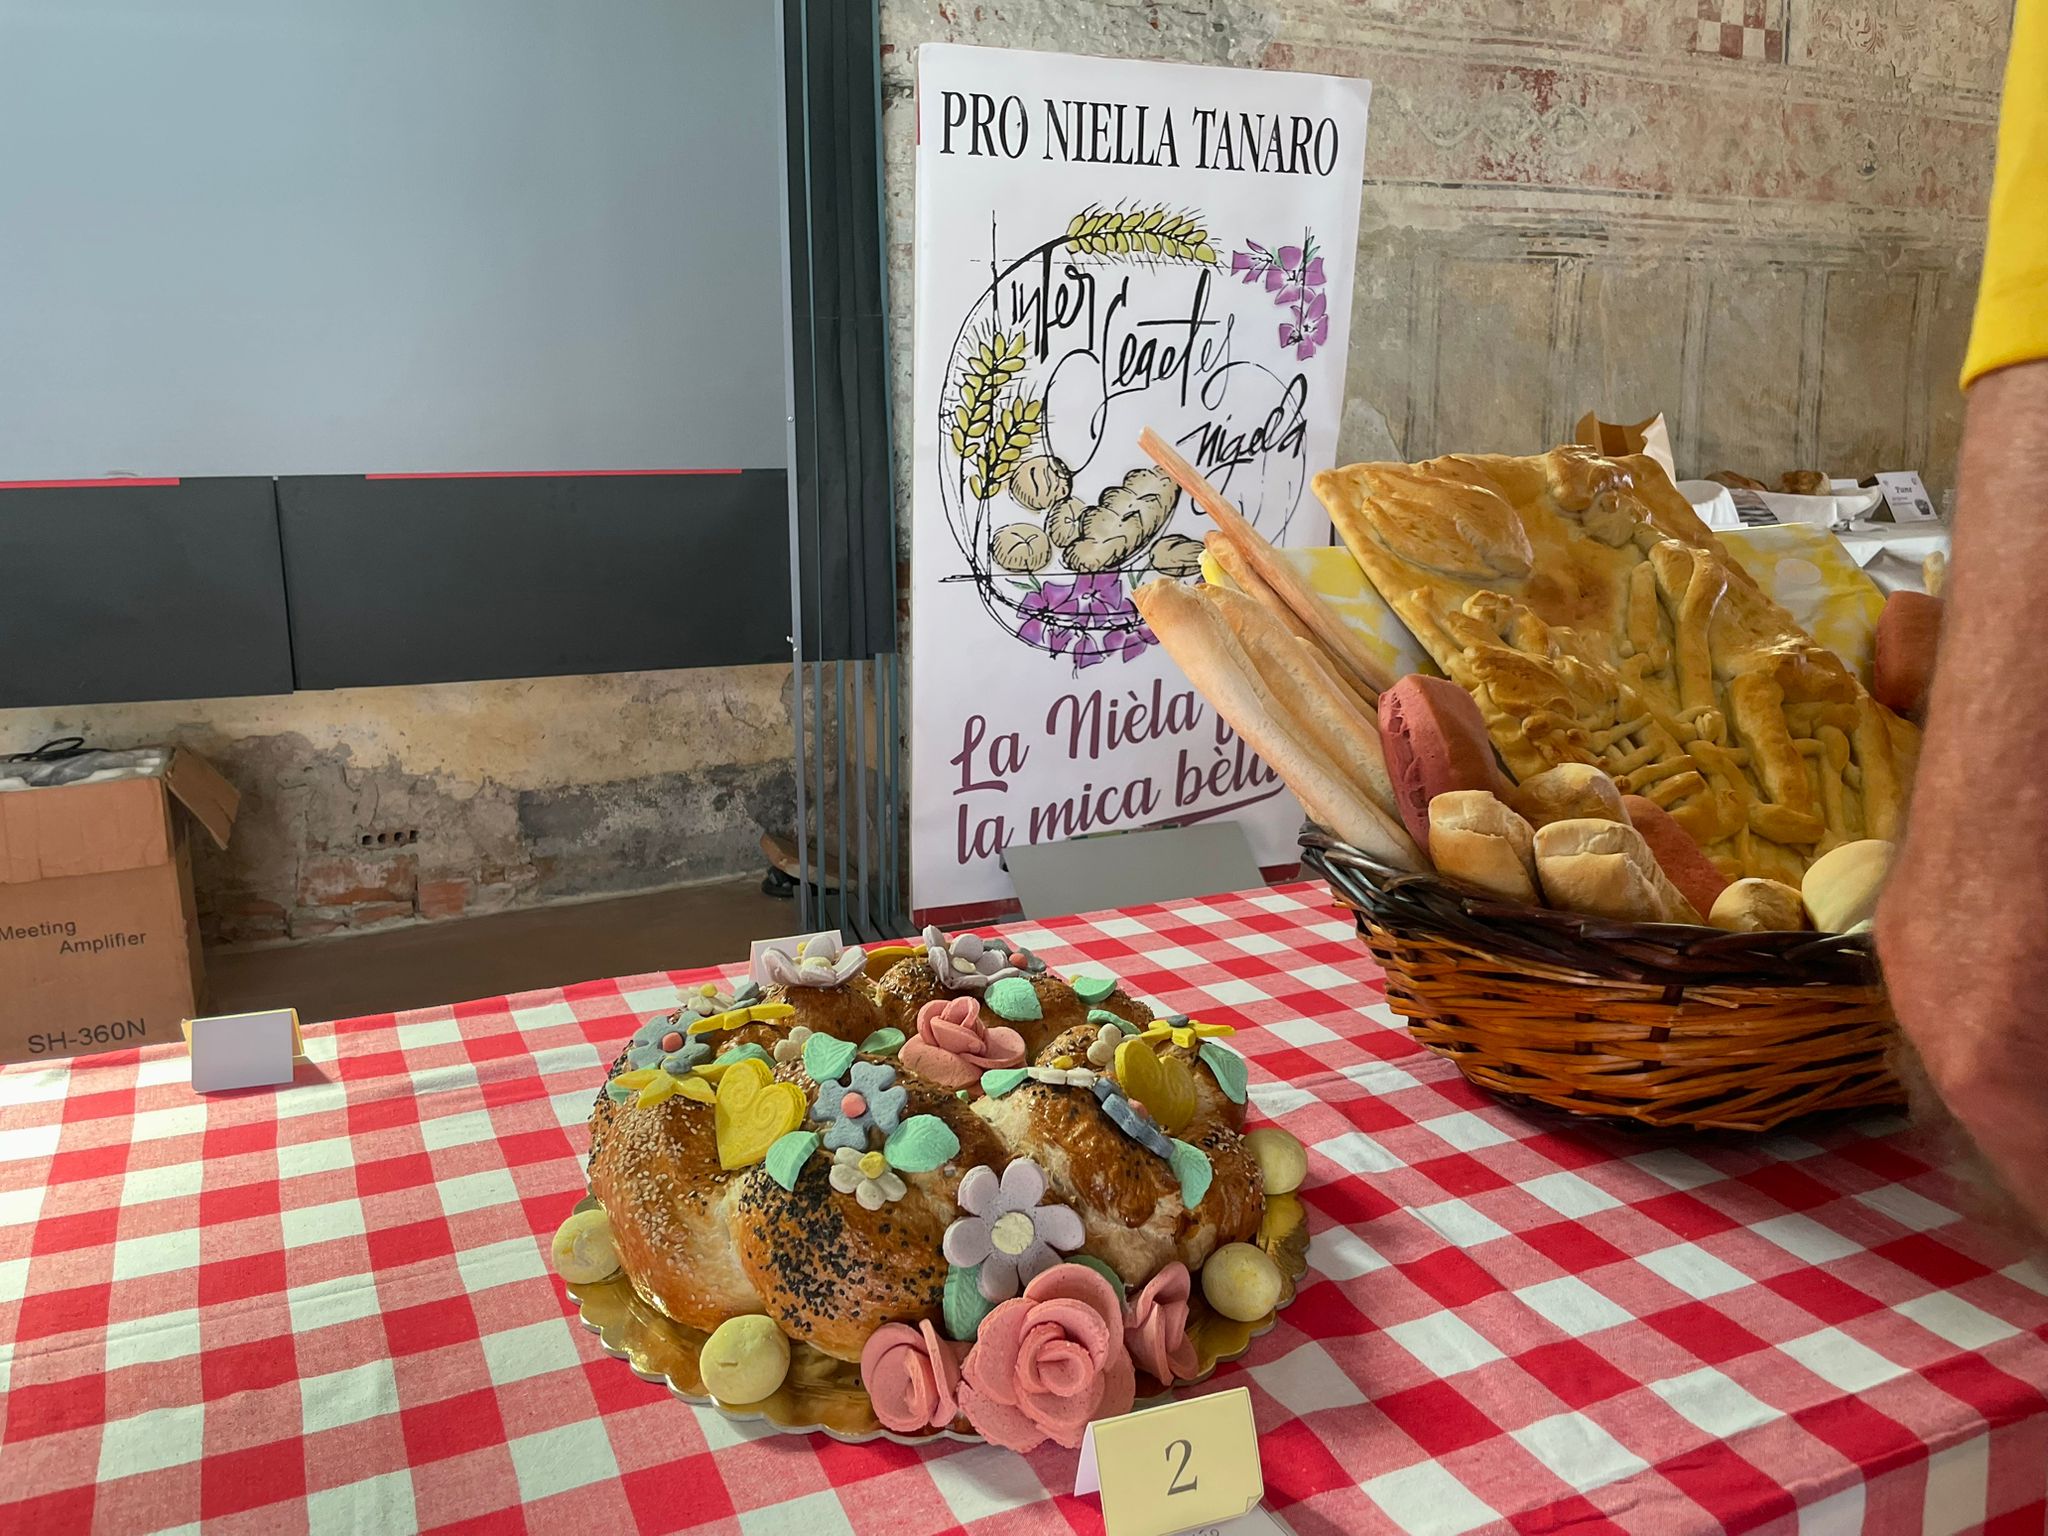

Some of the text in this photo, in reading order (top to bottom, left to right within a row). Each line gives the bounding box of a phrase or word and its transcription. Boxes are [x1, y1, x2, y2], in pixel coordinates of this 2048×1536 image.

[940, 91, 1340, 176] PRO NIELLA TANARO
[949, 714, 1030, 796] La
[1046, 678, 1204, 760] Nièla
[957, 803, 1015, 865] la
[1028, 777, 1160, 845] mica
[0, 920, 77, 941] Meeting
[59, 931, 147, 955] Amplifier
[27, 1017, 147, 1054] SH-360N
[1164, 1438, 1199, 1496] 2
